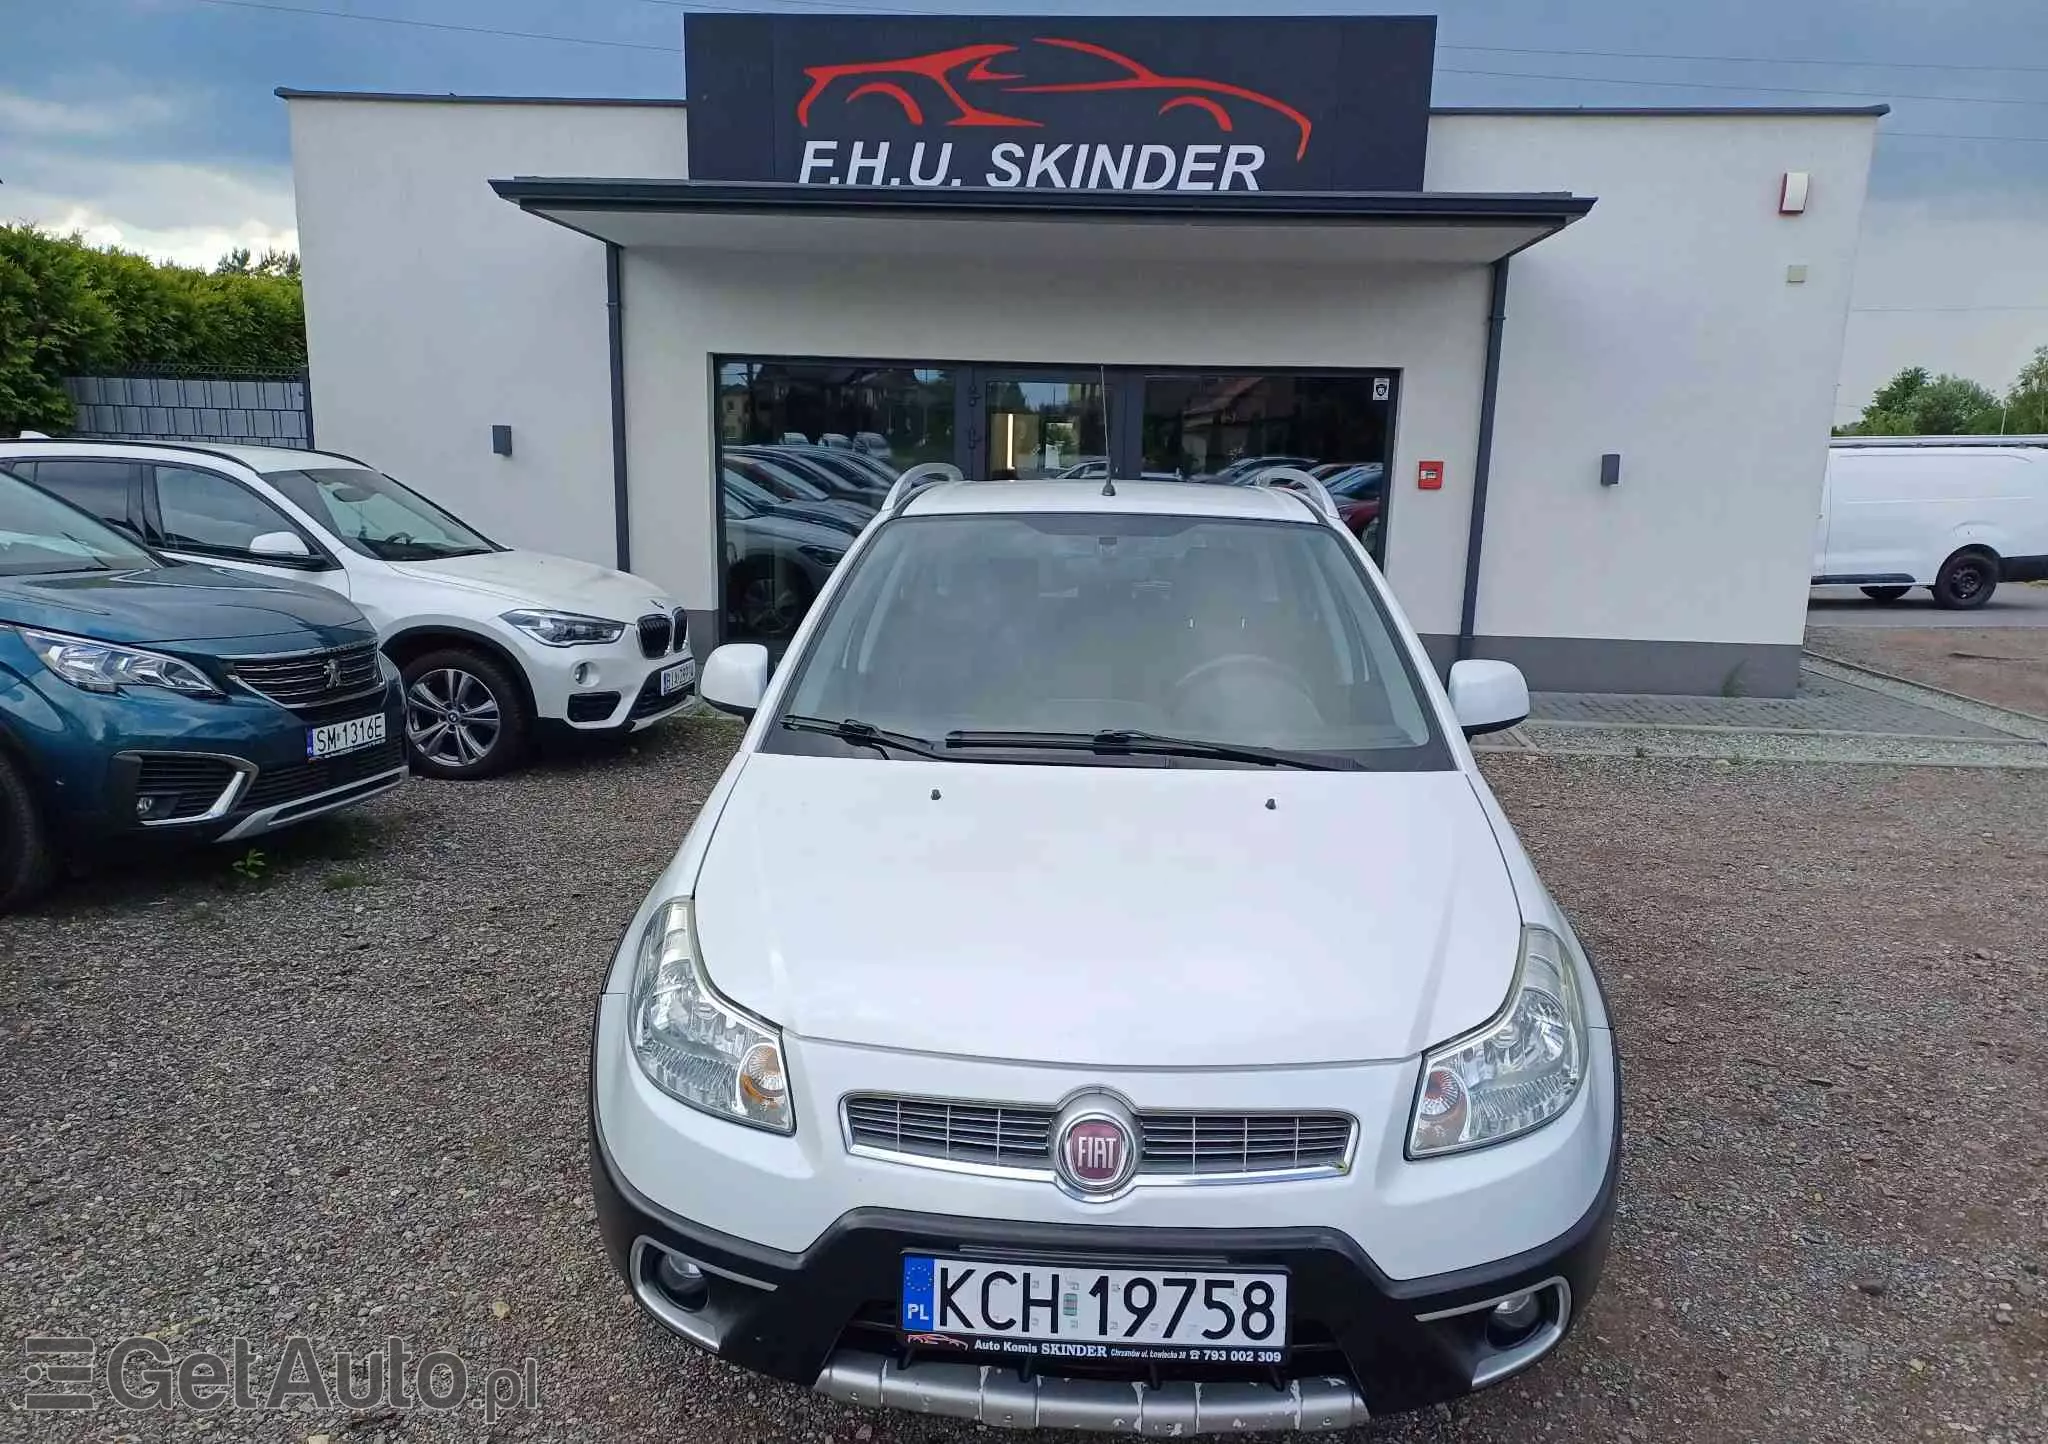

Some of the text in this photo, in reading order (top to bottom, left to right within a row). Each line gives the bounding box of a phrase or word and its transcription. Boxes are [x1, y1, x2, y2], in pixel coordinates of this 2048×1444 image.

[798, 140, 1266, 191] F.H.U. SKINDER
[316, 727, 337, 752] SM
[342, 715, 382, 746] 1316E
[1077, 1136, 1117, 1169] FIAT
[907, 1303, 929, 1320] PL
[939, 1267, 1275, 1341] KCH 19758
[974, 1339, 1000, 1351] Auto
[1003, 1341, 1038, 1353] Komis
[1041, 1343, 1109, 1357] SKINDER
[1203, 1350, 1227, 1361] 793
[1230, 1351, 1254, 1362] 002
[1257, 1351, 1282, 1362] 309
